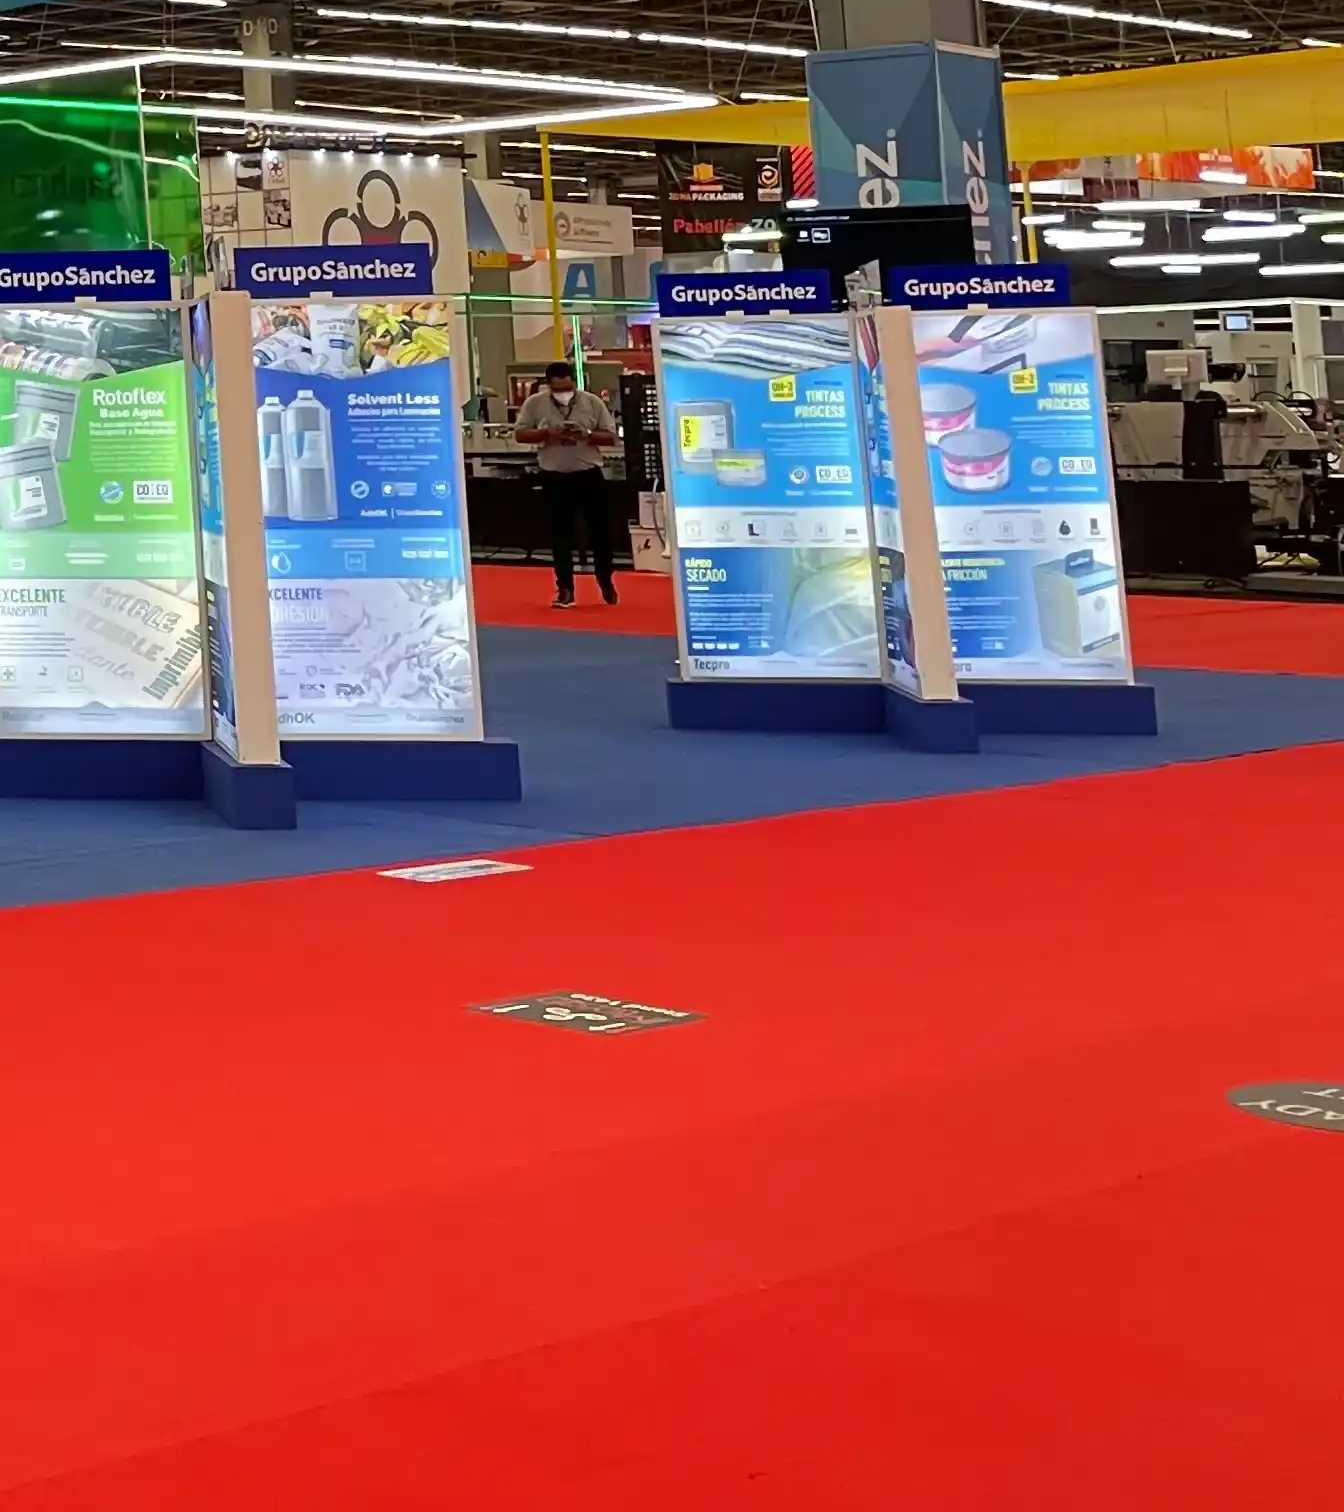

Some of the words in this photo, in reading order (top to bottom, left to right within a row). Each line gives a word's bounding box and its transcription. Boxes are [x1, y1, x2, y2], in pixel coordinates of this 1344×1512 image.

[250, 260, 416, 286] GrupoSánchez
[672, 283, 817, 306] GrupoSánchez
[904, 276, 1055, 300] GrupoSánchez
[1047, 382, 1089, 396] TINTAS
[92, 388, 167, 406] Rotoflex
[347, 392, 403, 406] Solvent
[405, 392, 440, 406] Less
[805, 390, 845, 403] TINTAS
[99, 408, 131, 419] Base
[131, 408, 165, 420] Agua
[794, 405, 846, 419] PROCESS
[686, 568, 727, 583] SECADO
[269, 588, 323, 601] CELENTE
[694, 658, 730, 671] Tecpro
[277, 712, 315, 725] dhOK
